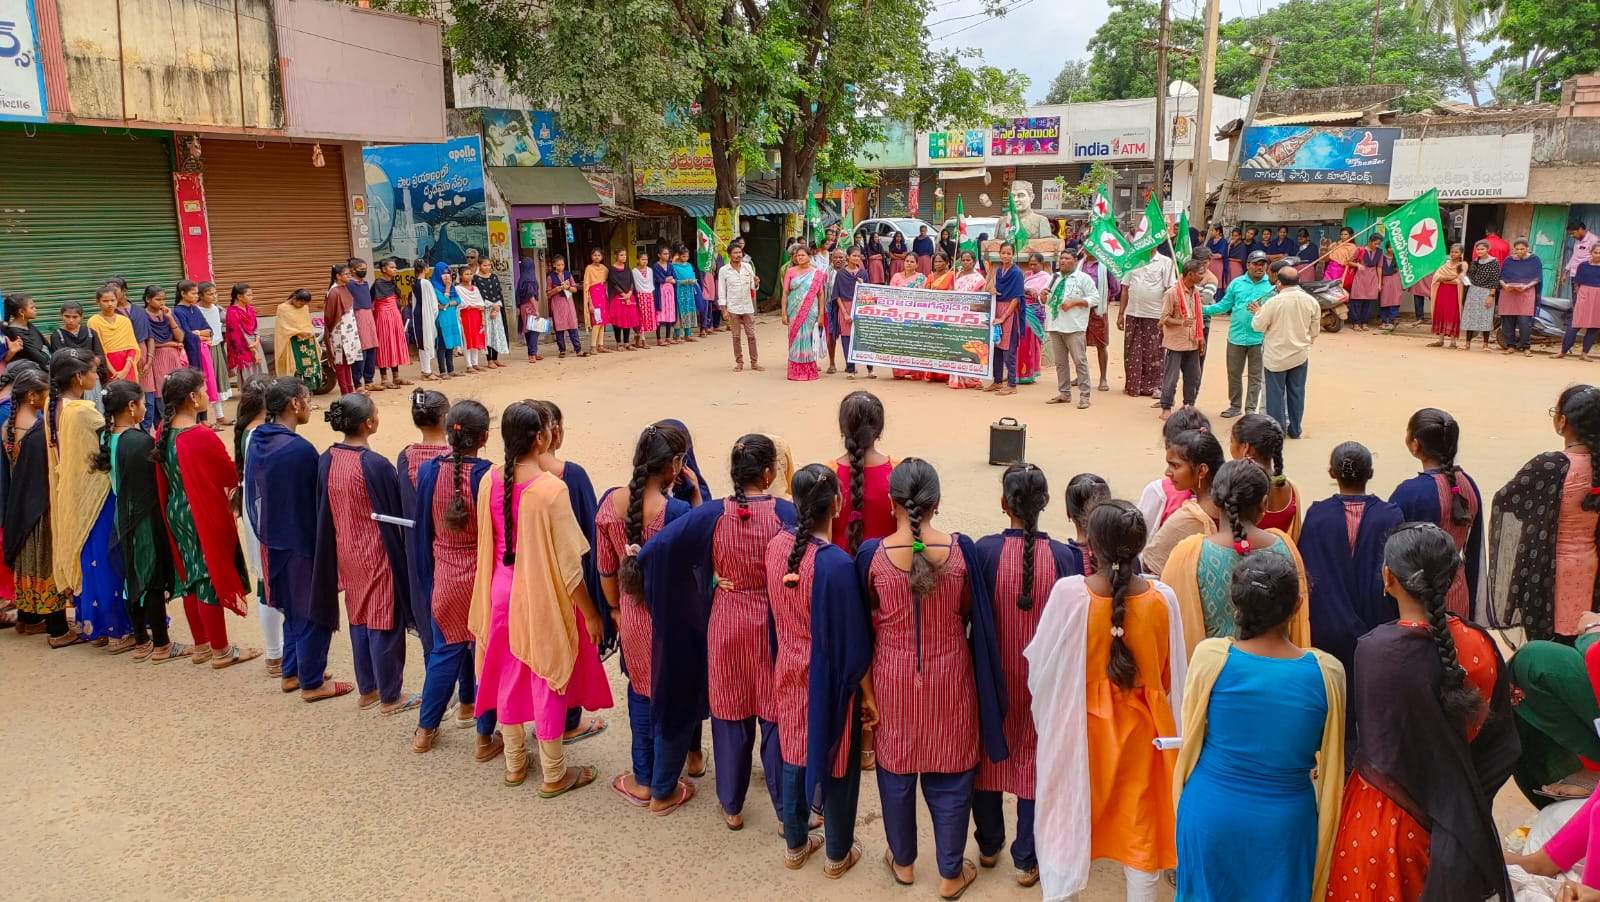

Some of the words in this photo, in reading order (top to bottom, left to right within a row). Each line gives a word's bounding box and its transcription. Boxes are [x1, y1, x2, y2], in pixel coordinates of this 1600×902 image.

[448, 145, 476, 162] apollo
[1074, 142, 1109, 157] india
[1121, 142, 1145, 155] ATM
